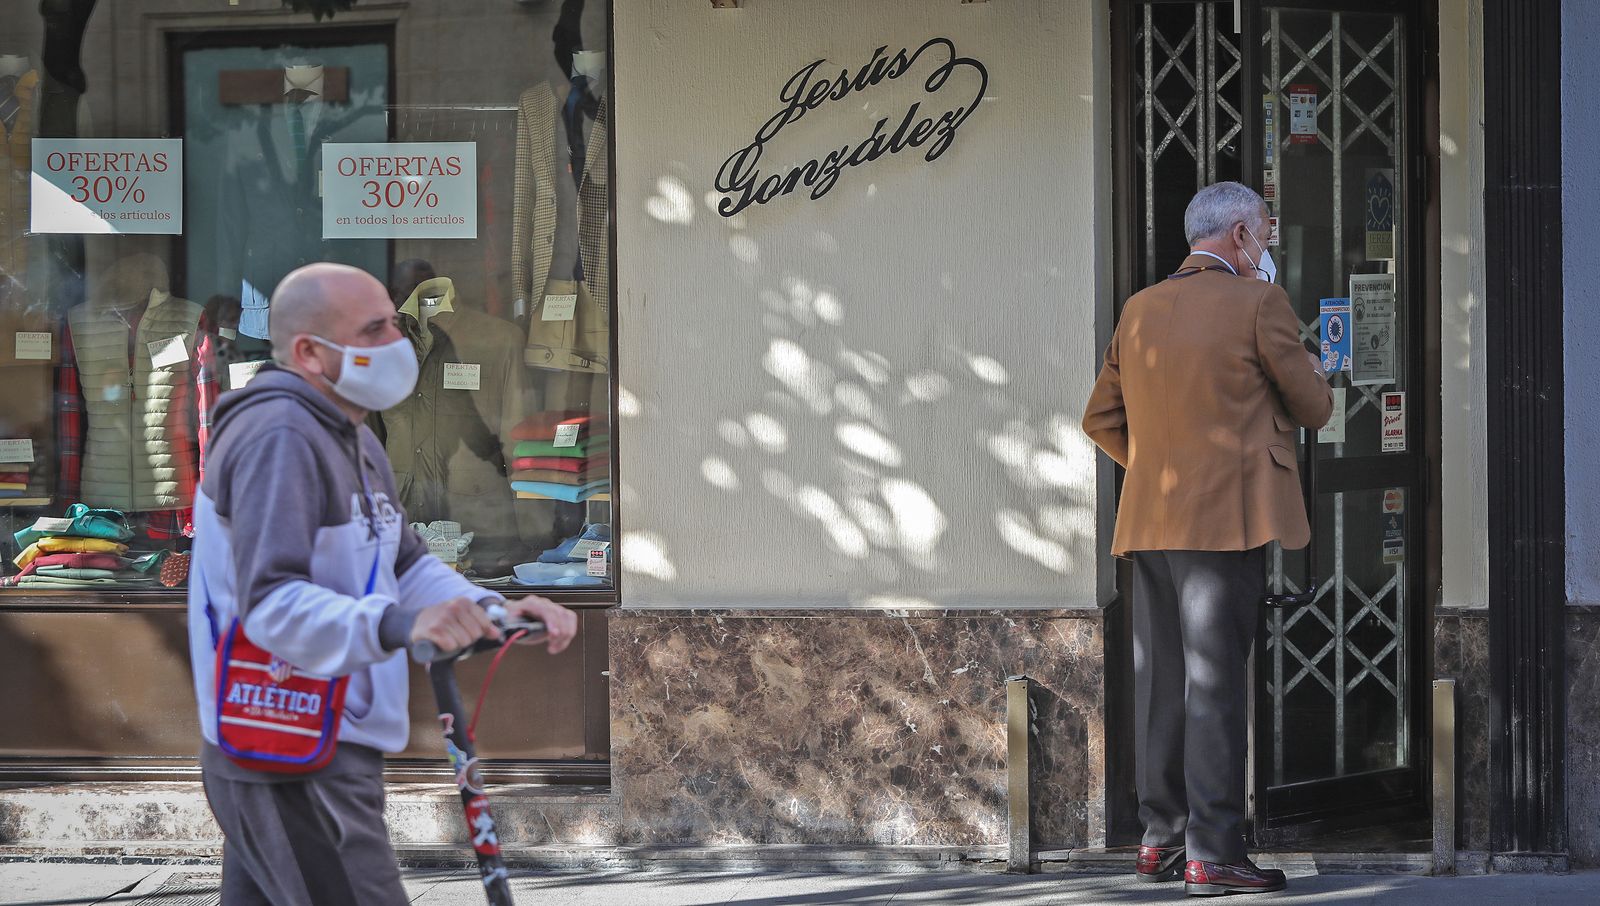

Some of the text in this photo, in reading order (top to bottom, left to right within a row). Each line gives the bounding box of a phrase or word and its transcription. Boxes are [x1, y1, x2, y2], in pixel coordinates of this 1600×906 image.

[755, 38, 955, 144] Jesús
[46, 152, 168, 173] OFERTAS
[337, 156, 462, 177] OFERTAS
[714, 100, 966, 218] González
[70, 176, 146, 204] 30%
[361, 180, 439, 208] 30%
[99, 209, 117, 221] los
[336, 216, 351, 225] en
[355, 214, 388, 225] todos
[391, 214, 409, 225] los
